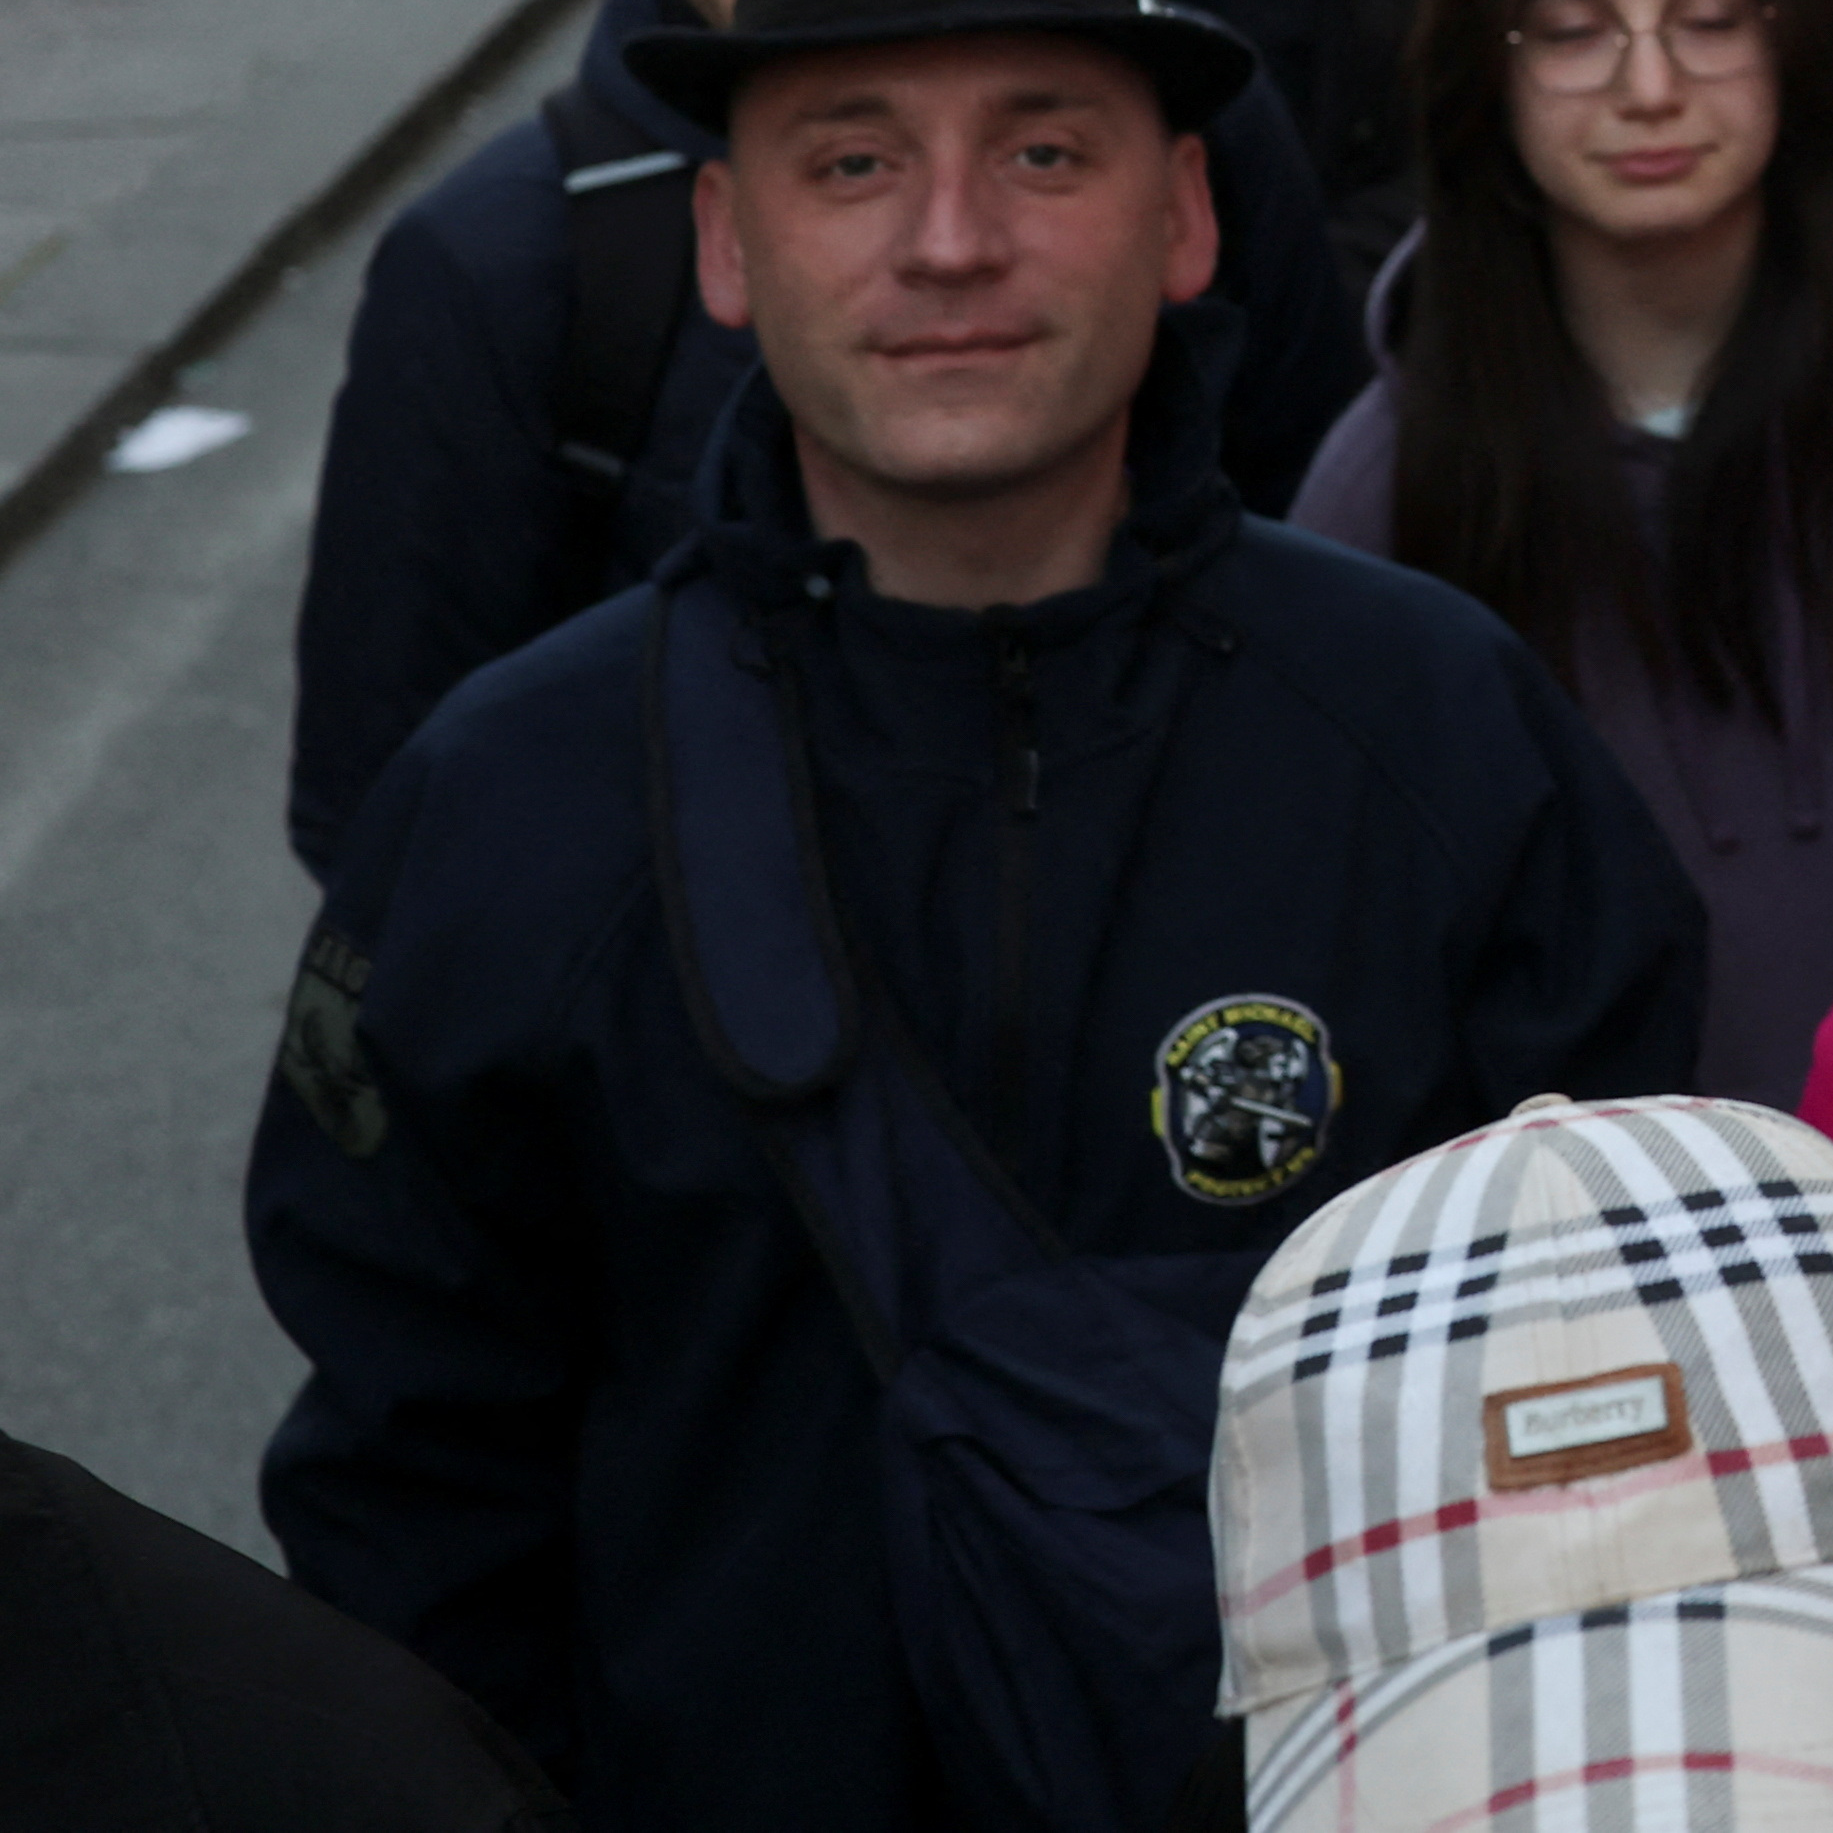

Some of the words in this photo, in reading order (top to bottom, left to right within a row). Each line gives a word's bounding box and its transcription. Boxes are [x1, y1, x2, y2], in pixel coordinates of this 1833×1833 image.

[1166, 1012, 1219, 1067] SAINT
[1222, 1003, 1316, 1044] MICHAEL
[1524, 1397, 1644, 1436] Burberry
